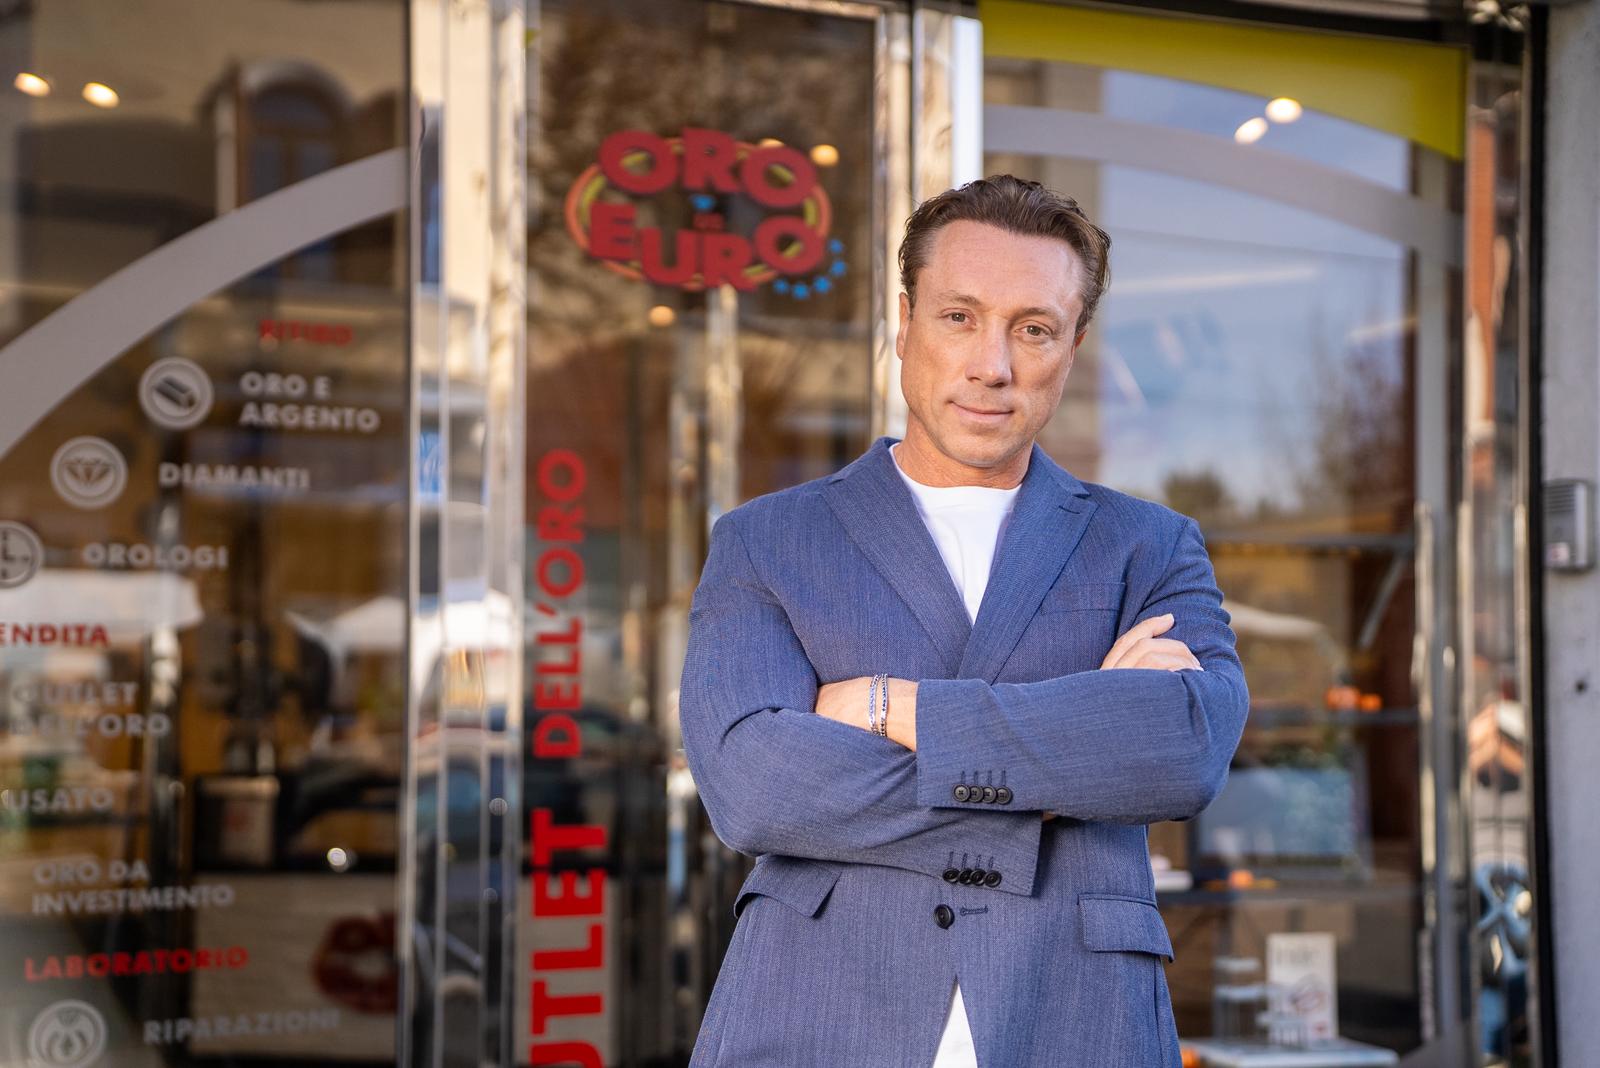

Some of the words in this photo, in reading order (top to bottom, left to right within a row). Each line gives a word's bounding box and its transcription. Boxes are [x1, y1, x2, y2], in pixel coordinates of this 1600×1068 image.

[598, 126, 818, 208] ORO
[588, 201, 826, 292] EURO
[239, 371, 308, 399] ORO
[313, 375, 332, 400] E
[239, 401, 381, 433] ARGENTO
[158, 461, 310, 491] DIAMANTI
[81, 542, 229, 570] OROLOGI
[532, 448, 588, 758] DELL'ORO
[8, 786, 115, 812] USATO
[32, 860, 100, 885] ORO
[108, 859, 150, 881] DA
[31, 884, 236, 916] INVESTIMENTO
[24, 945, 250, 983] LABORATORIO
[143, 1008, 339, 1045] RIPARAZIONI
